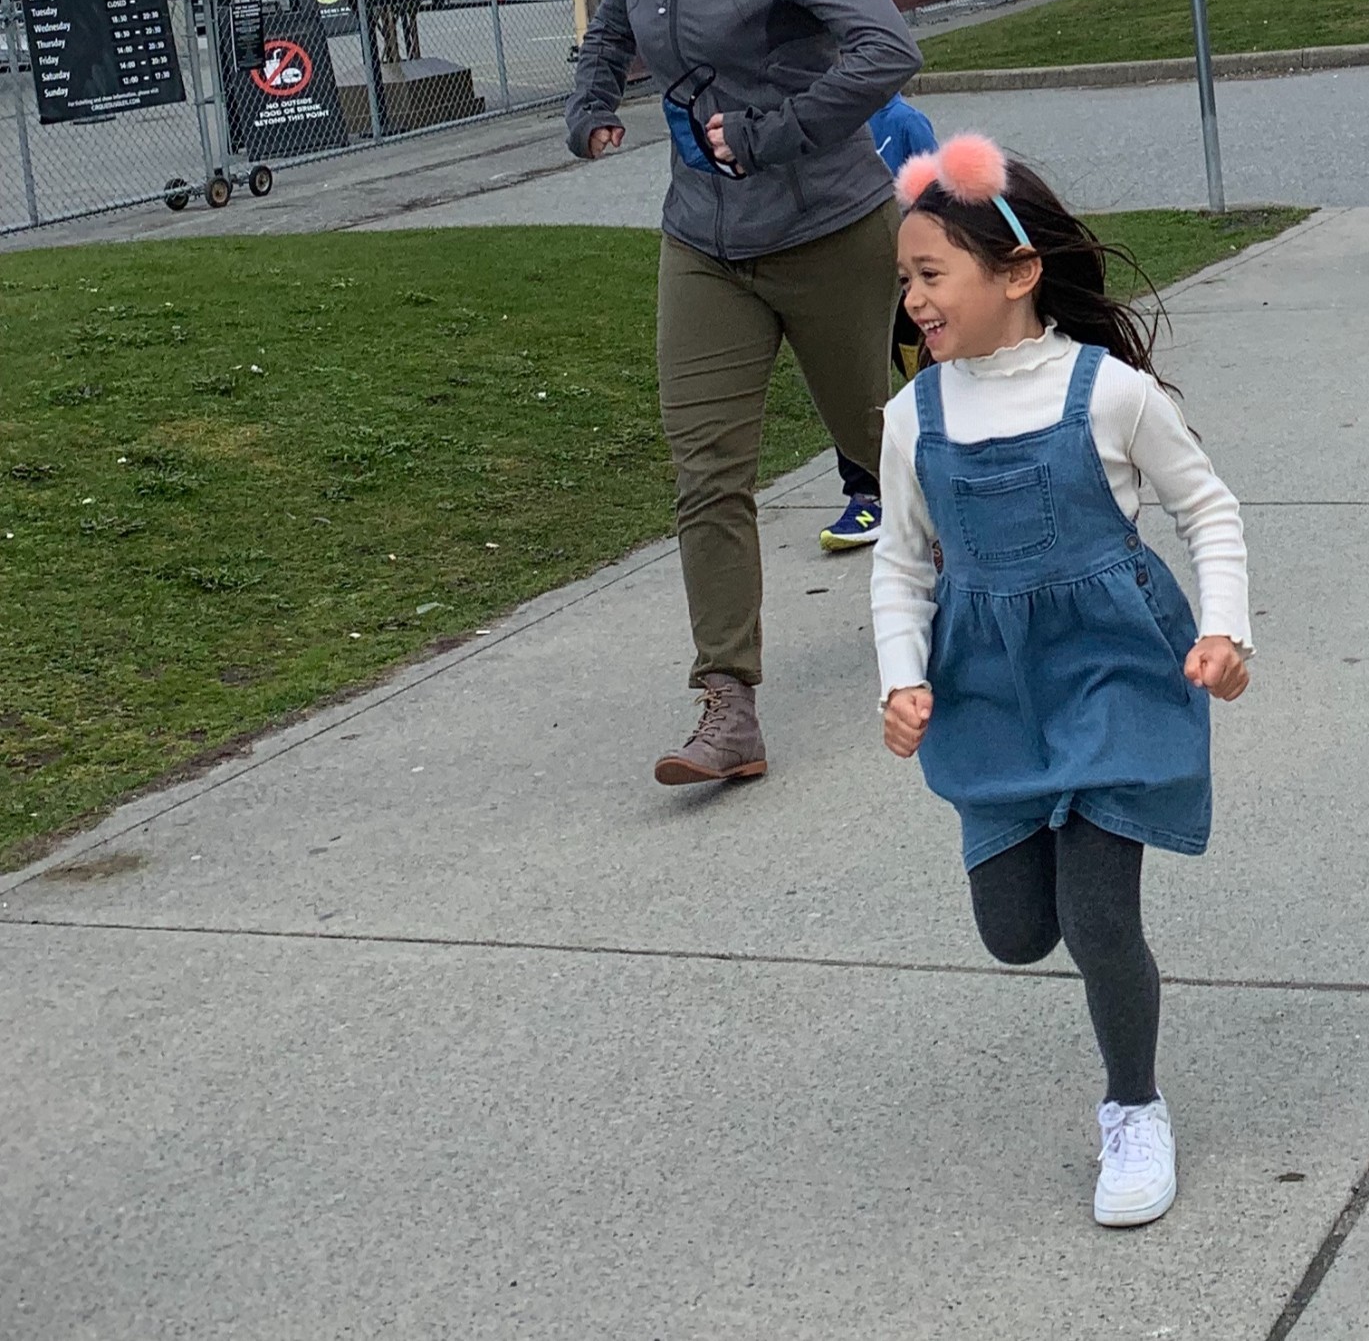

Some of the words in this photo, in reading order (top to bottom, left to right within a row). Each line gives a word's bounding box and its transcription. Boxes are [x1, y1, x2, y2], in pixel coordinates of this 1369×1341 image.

[31, 6, 58, 17] Tuesday
[107, 0, 127, 8] CLOSED
[33, 21, 71, 33] Wednesday
[36, 37, 66, 49] Thursday
[38, 55, 59, 66] Friday
[41, 69, 70, 82] Saturday
[44, 86, 68, 98] Sunday
[265, 102, 279, 110] NO
[280, 98, 313, 108] OUTSIDE
[259, 109, 282, 119] FOOD
[283, 107, 295, 115] OR
[296, 103, 322, 113] DRINK
[254, 116, 287, 128] BEYOND
[287, 113, 305, 122] THIS
[306, 110, 329, 119] POINT
[855, 510, 875, 528] N
